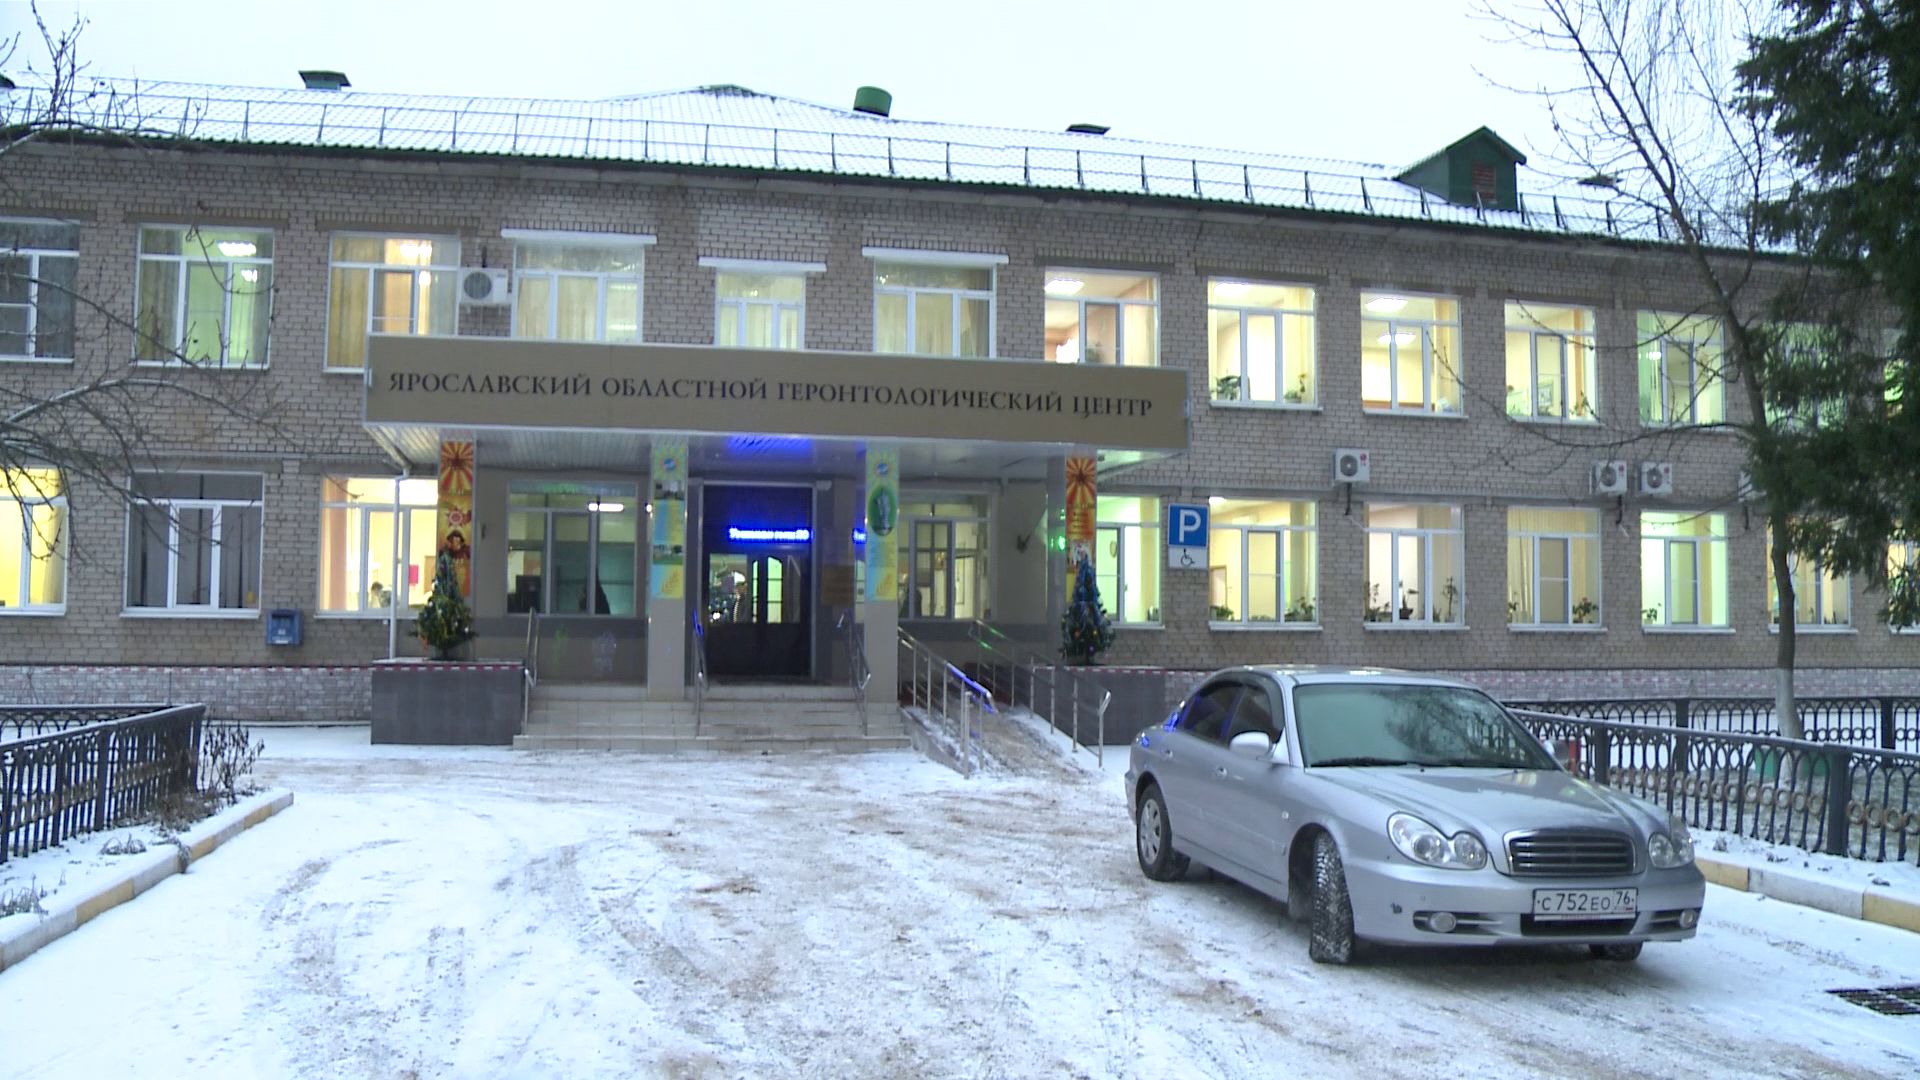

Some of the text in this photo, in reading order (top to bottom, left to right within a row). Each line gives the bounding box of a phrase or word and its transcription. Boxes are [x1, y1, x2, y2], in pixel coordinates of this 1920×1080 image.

[389, 372, 1153, 419] ЯРОСЛАВСКИЙ ОБЛАСТНОЙ ГЕРОНТОЛОГИЧЕСКИЙ ЦЕНТР
[1179, 509, 1202, 543] P
